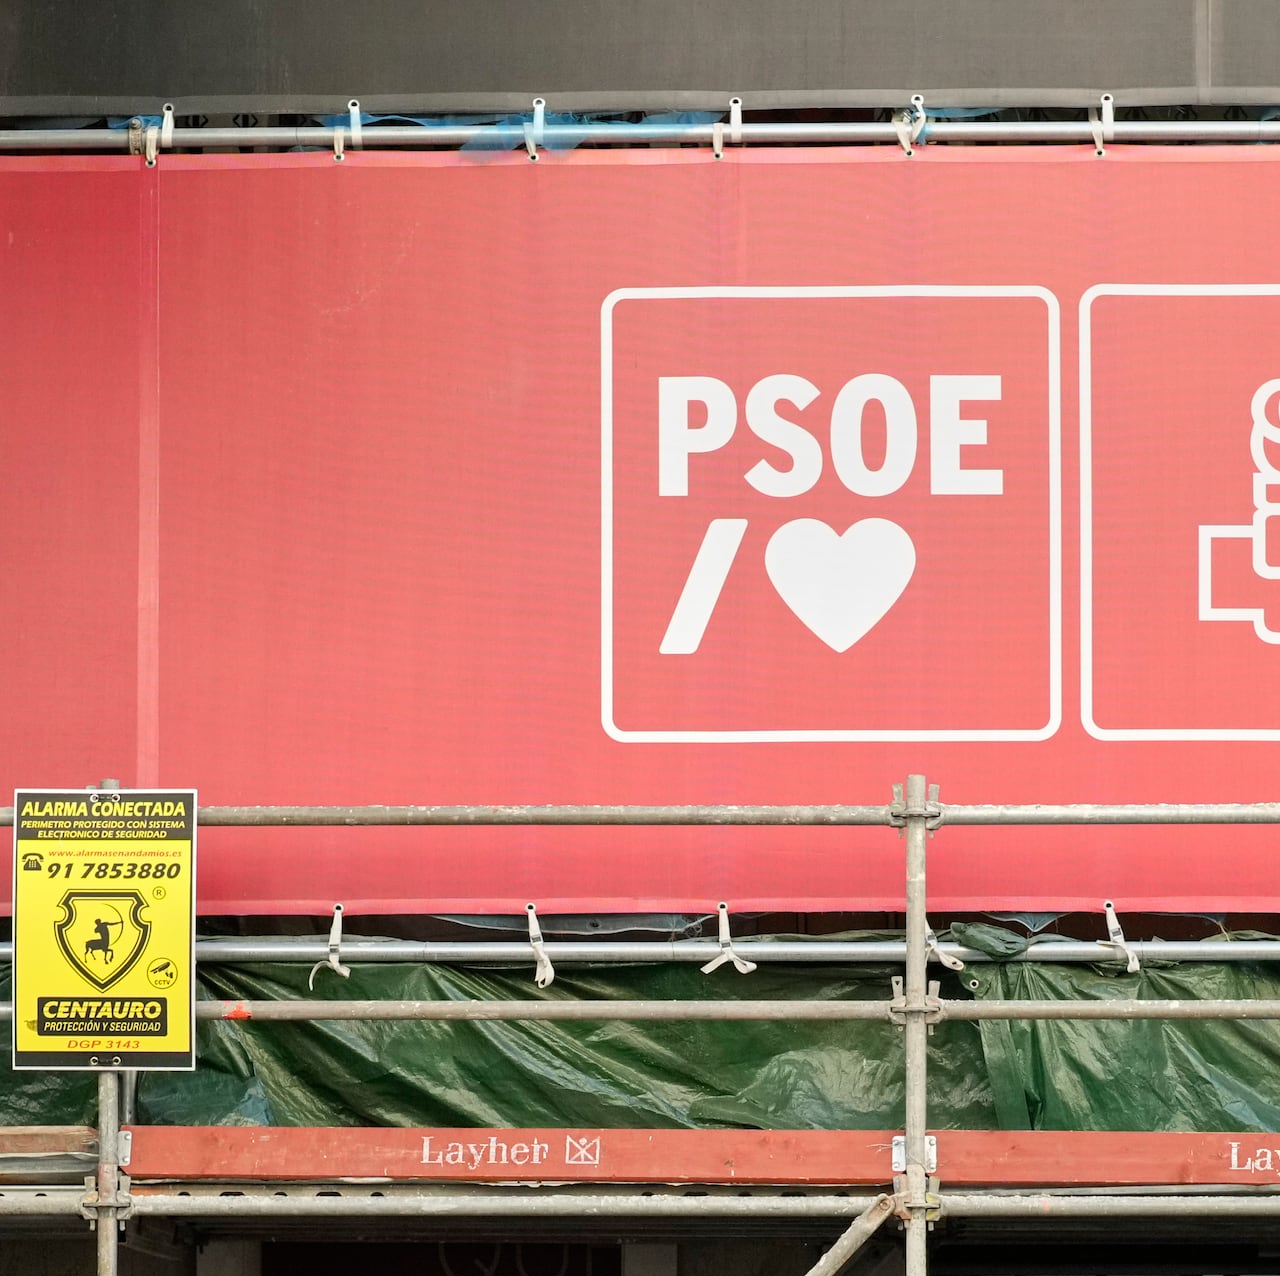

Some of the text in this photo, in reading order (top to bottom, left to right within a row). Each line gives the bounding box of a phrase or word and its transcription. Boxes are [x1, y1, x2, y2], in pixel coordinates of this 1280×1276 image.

[658, 373, 1004, 498] PSOE
[20, 801, 186, 817] ALARMA CONECTADA
[20, 820, 186, 829] PERIMETRO PROTEGIDO CON SISTEMA
[37, 830, 168, 839] ELECTRONICO DE SEGURIDAD
[48, 849, 183, 858] www.alarmasenandamios.es
[47, 862, 182, 879] 91 7853880
[42, 1000, 162, 1019] CENTAURO
[43, 1020, 161, 1032] PROTECCIÓN Y SEGURIDAD
[67, 1040, 140, 1049] DGP 3143
[420, 1135, 550, 1170] Layher
